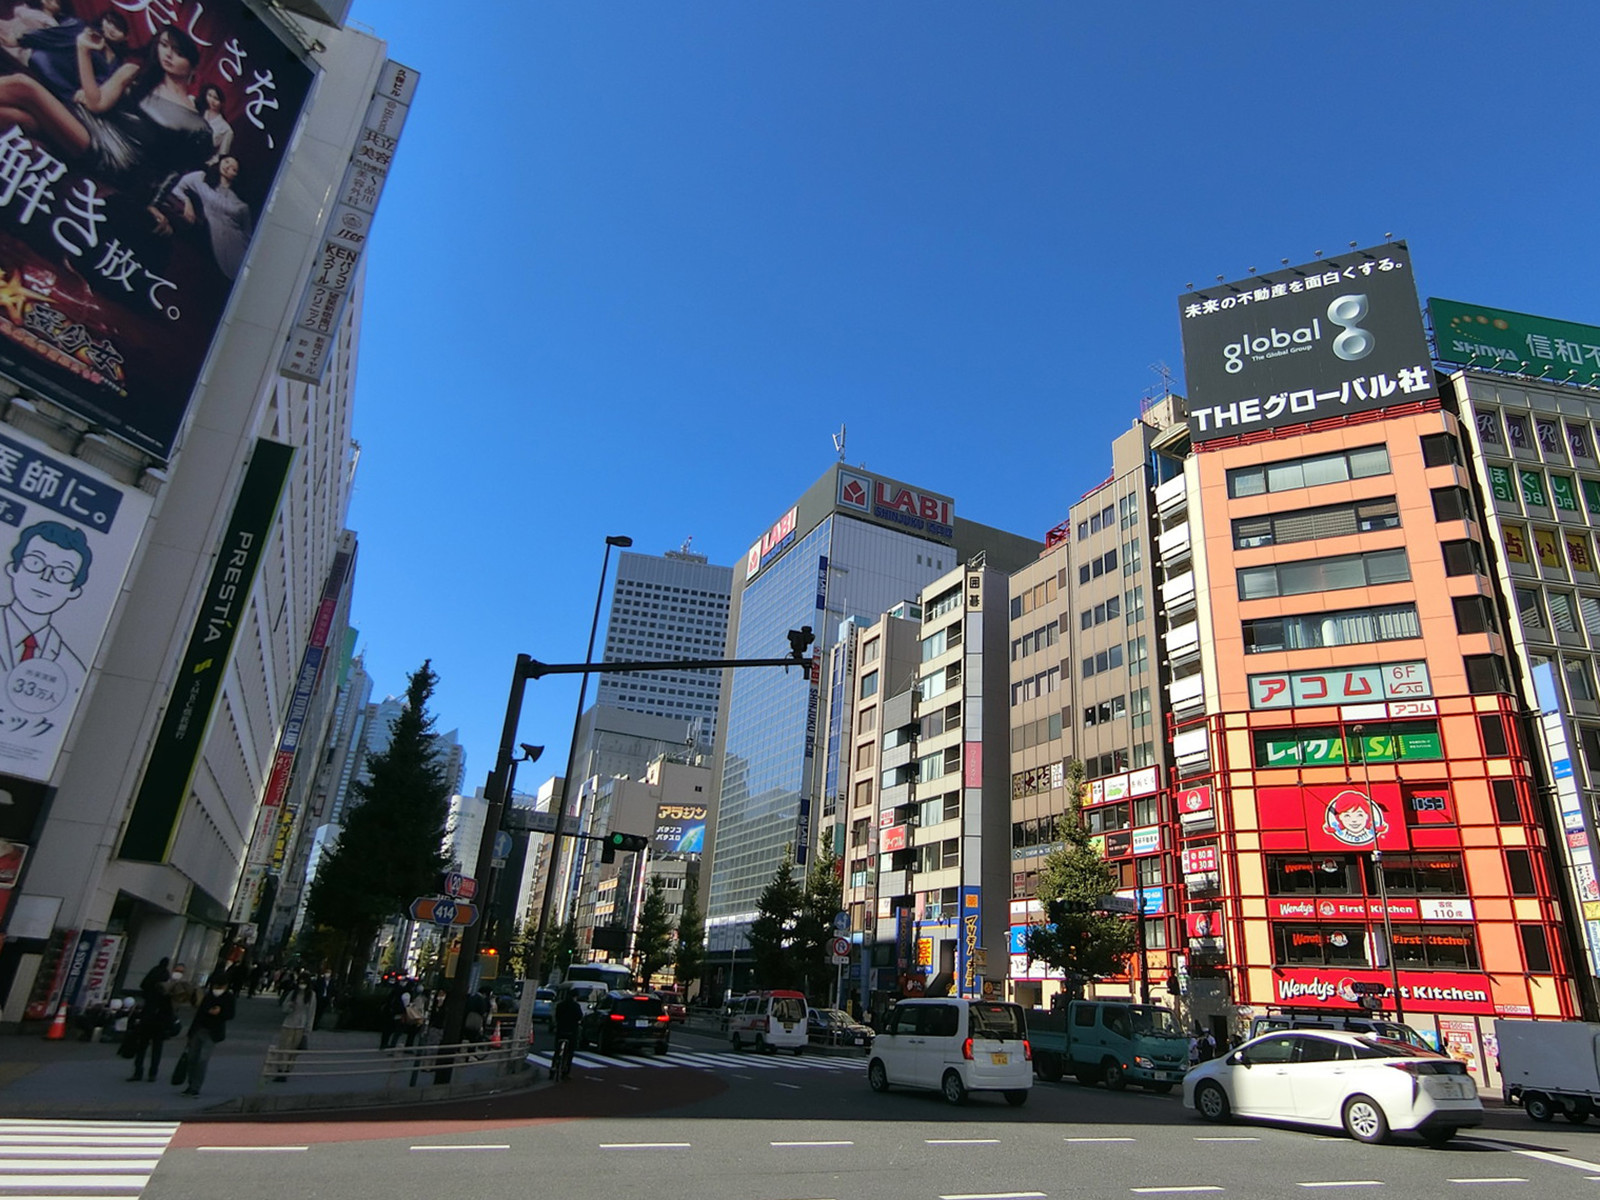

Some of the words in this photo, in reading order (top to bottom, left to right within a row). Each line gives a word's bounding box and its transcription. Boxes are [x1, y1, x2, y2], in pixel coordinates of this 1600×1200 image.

[324, 244, 357, 263] KEN
[318, 255, 336, 285] スクール
[1185, 258, 1403, 318] 未来の不動産を面白くする。
[1223, 318, 1321, 374] global
[1251, 354, 1265, 362] The
[1265, 349, 1289, 360] Global
[1290, 344, 1313, 355] Group
[1191, 365, 1431, 432] THEグローバル社
[874, 479, 954, 526] LABI
[762, 506, 798, 556] LABI
[1393, 665, 1416, 680] 6F
[13, 678, 57, 703] 33万人
[1258, 673, 1373, 703] アコム
[1406, 685, 1424, 694] 入口
[1394, 702, 1433, 715] アコム
[0, 708, 54, 738] ック
[658, 805, 708, 820] アラジン
[656, 825, 682, 834] パチンコ
[435, 905, 455, 919] 414
[1279, 902, 1314, 916] Wendy's
[1339, 905, 1366, 913] First
[1393, 934, 1422, 945] First
[71, 951, 87, 976] BOSS
[89, 938, 115, 991] KIRIN
[1278, 977, 1335, 1000] Wendy's
[1413, 985, 1487, 1002] Kitchen
